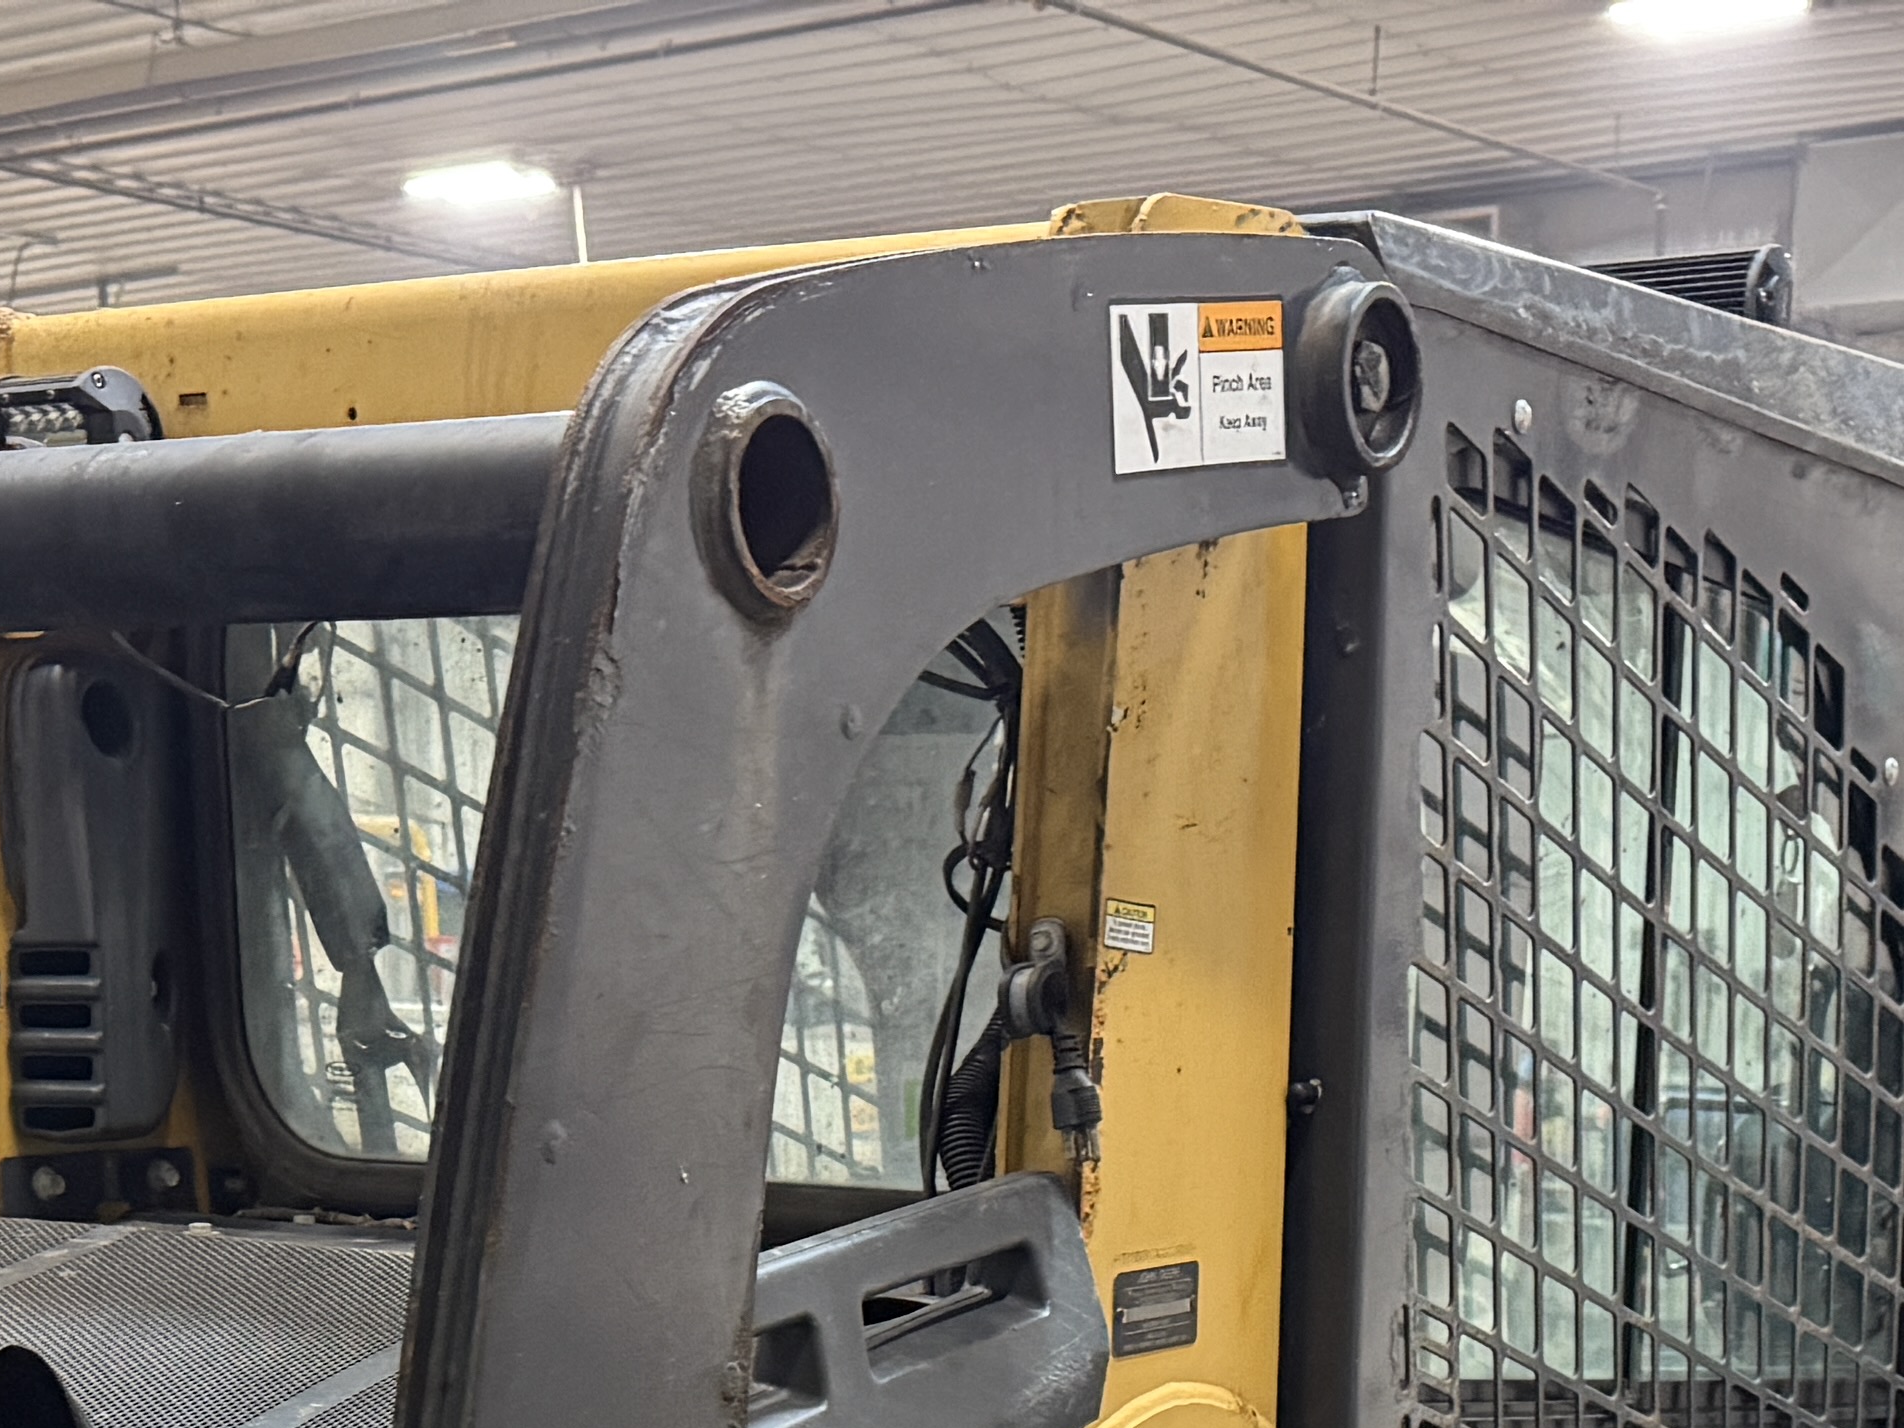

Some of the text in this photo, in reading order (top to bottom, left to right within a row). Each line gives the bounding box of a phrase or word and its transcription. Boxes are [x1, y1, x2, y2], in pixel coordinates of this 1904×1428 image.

[1215, 316, 1275, 337] WARNING
[1212, 373, 1272, 393] Pinch Area
